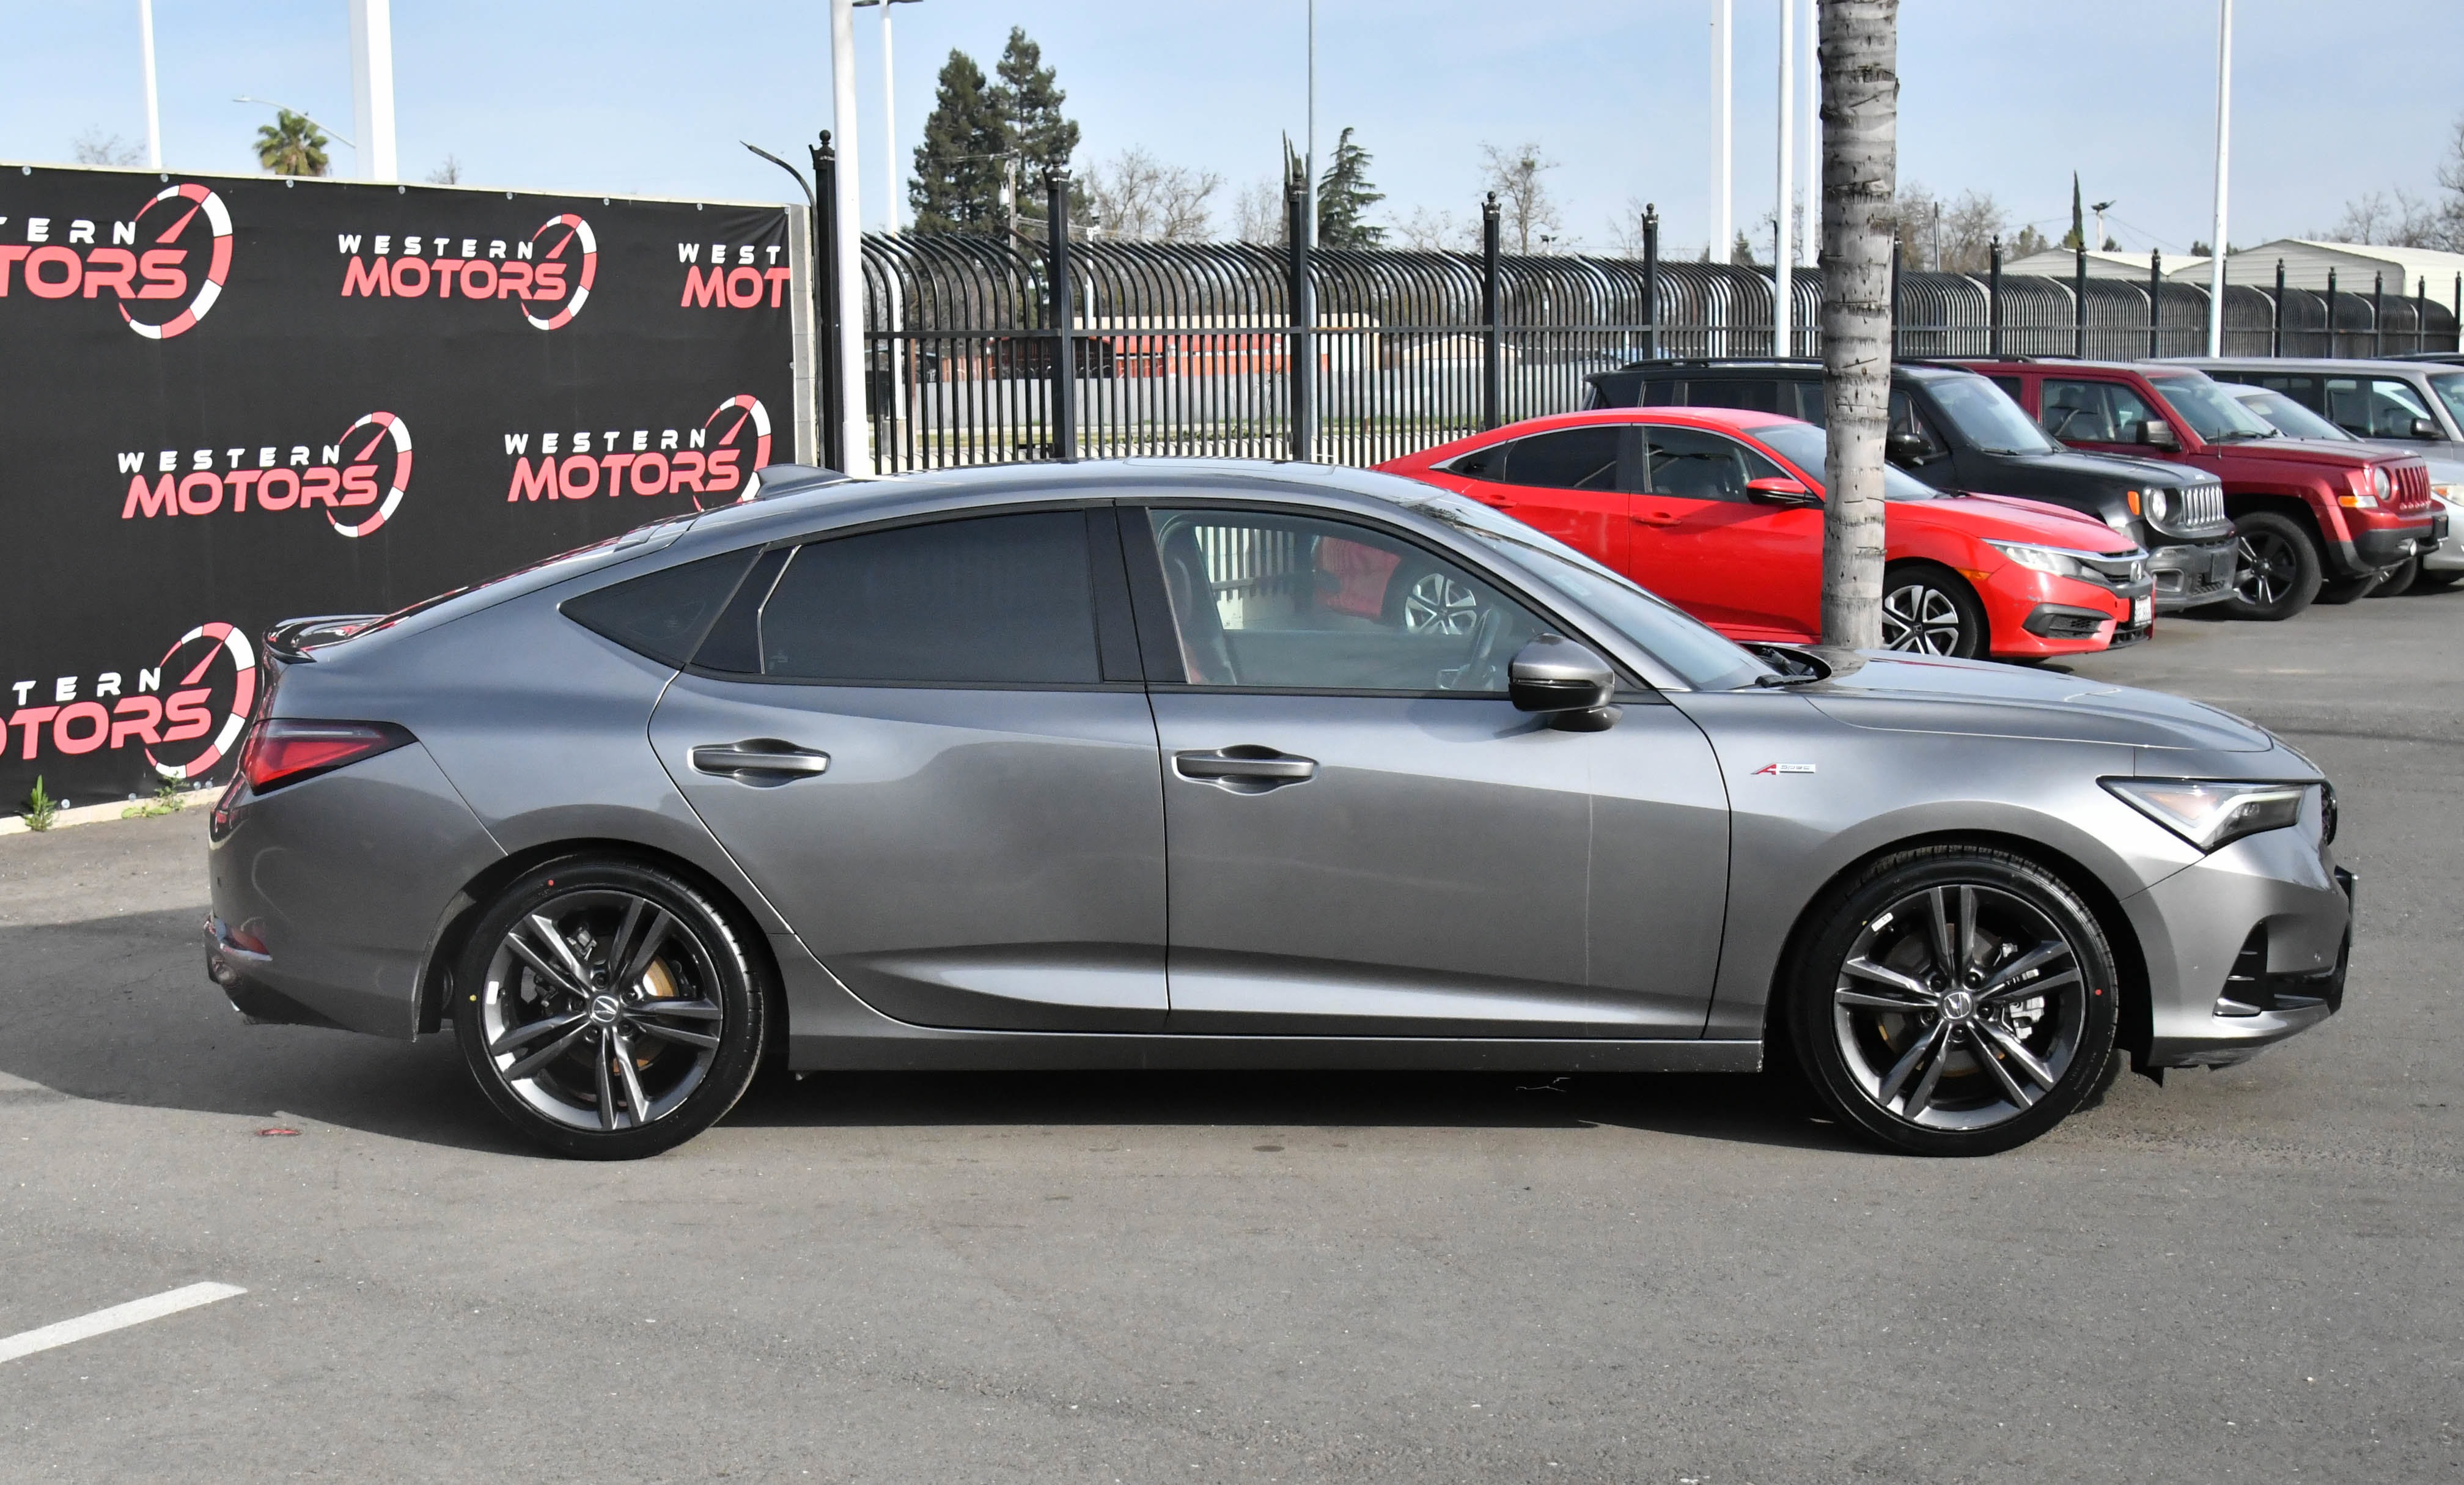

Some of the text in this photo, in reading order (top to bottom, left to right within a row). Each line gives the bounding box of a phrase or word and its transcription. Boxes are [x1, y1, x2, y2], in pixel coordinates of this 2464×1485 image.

[0, 216, 136, 245] ERN
[338, 234, 534, 260] WESTERN
[678, 243, 782, 265] WEST
[341, 256, 567, 301] MOTORS
[680, 265, 791, 309] MOT
[117, 444, 340, 474] WESTERN
[504, 428, 707, 455] WESTERN
[122, 464, 379, 519] MOTORS
[507, 449, 740, 503] MOTORS
[12, 667, 161, 706] TERN
[0, 688, 212, 760] TORS
